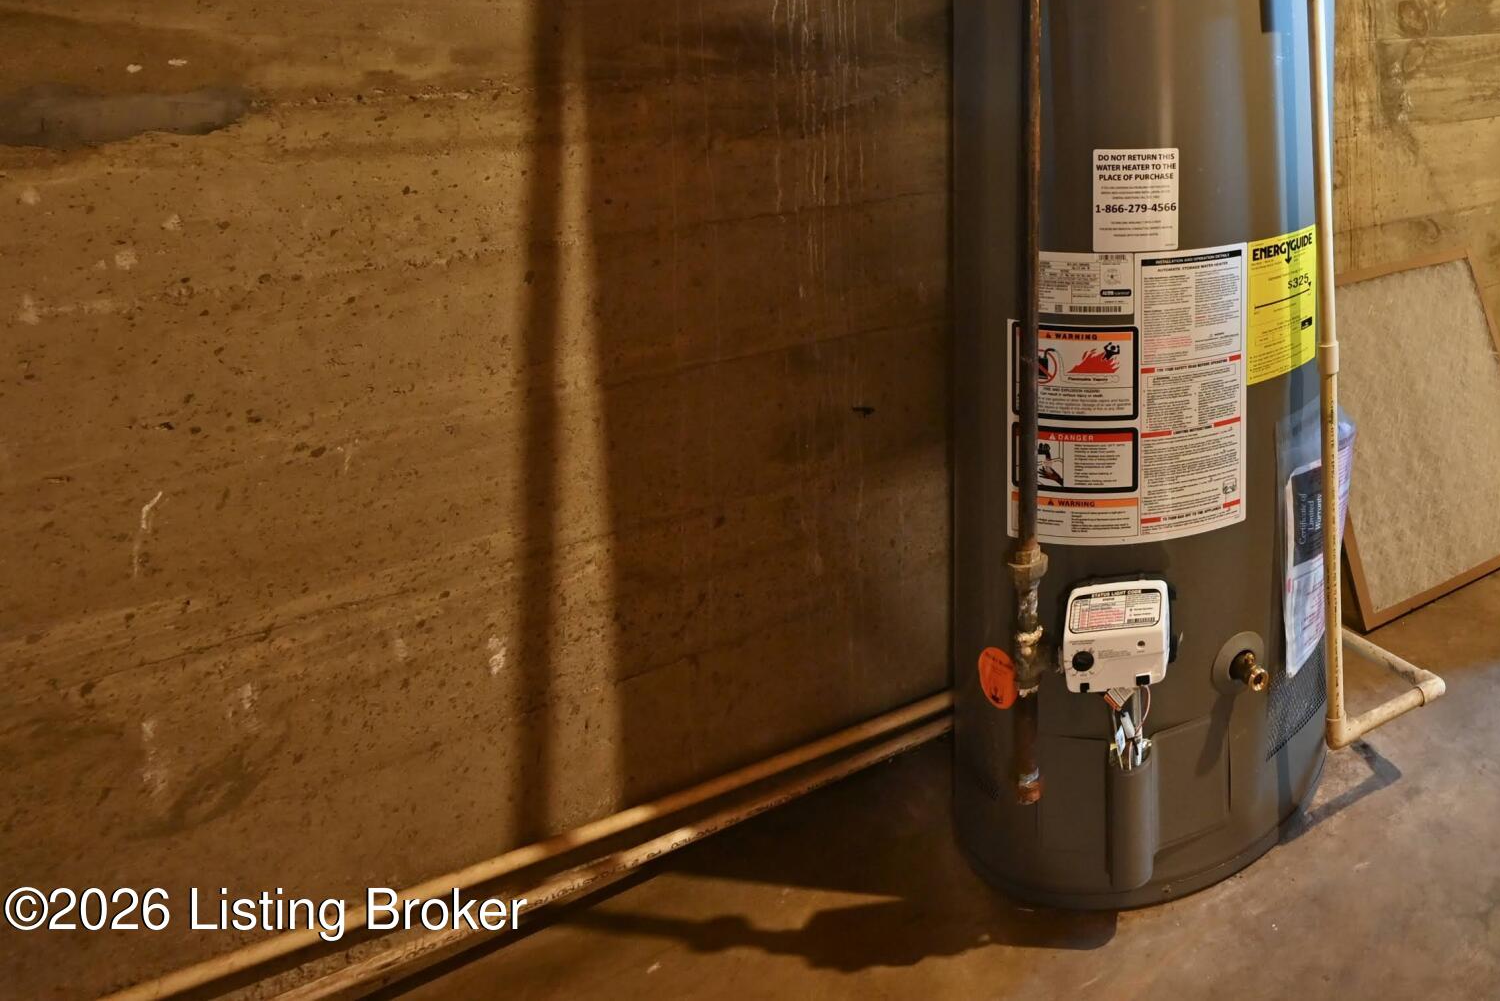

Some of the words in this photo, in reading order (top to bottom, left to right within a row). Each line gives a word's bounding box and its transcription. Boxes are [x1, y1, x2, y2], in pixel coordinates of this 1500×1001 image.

[1127, 153, 1157, 161] RETURN
[1122, 163, 1150, 171] HEATER
[1162, 162, 1177, 170] THE
[1122, 173, 1133, 181] OF
[1134, 172, 1174, 181] PURCHASE
[1095, 202, 1177, 213] 1-866-279-4566
[1252, 232, 1313, 264] ENERGYGUIDE
[1287, 272, 1309, 290] $325
[1058, 499, 1096, 507] WARNING
